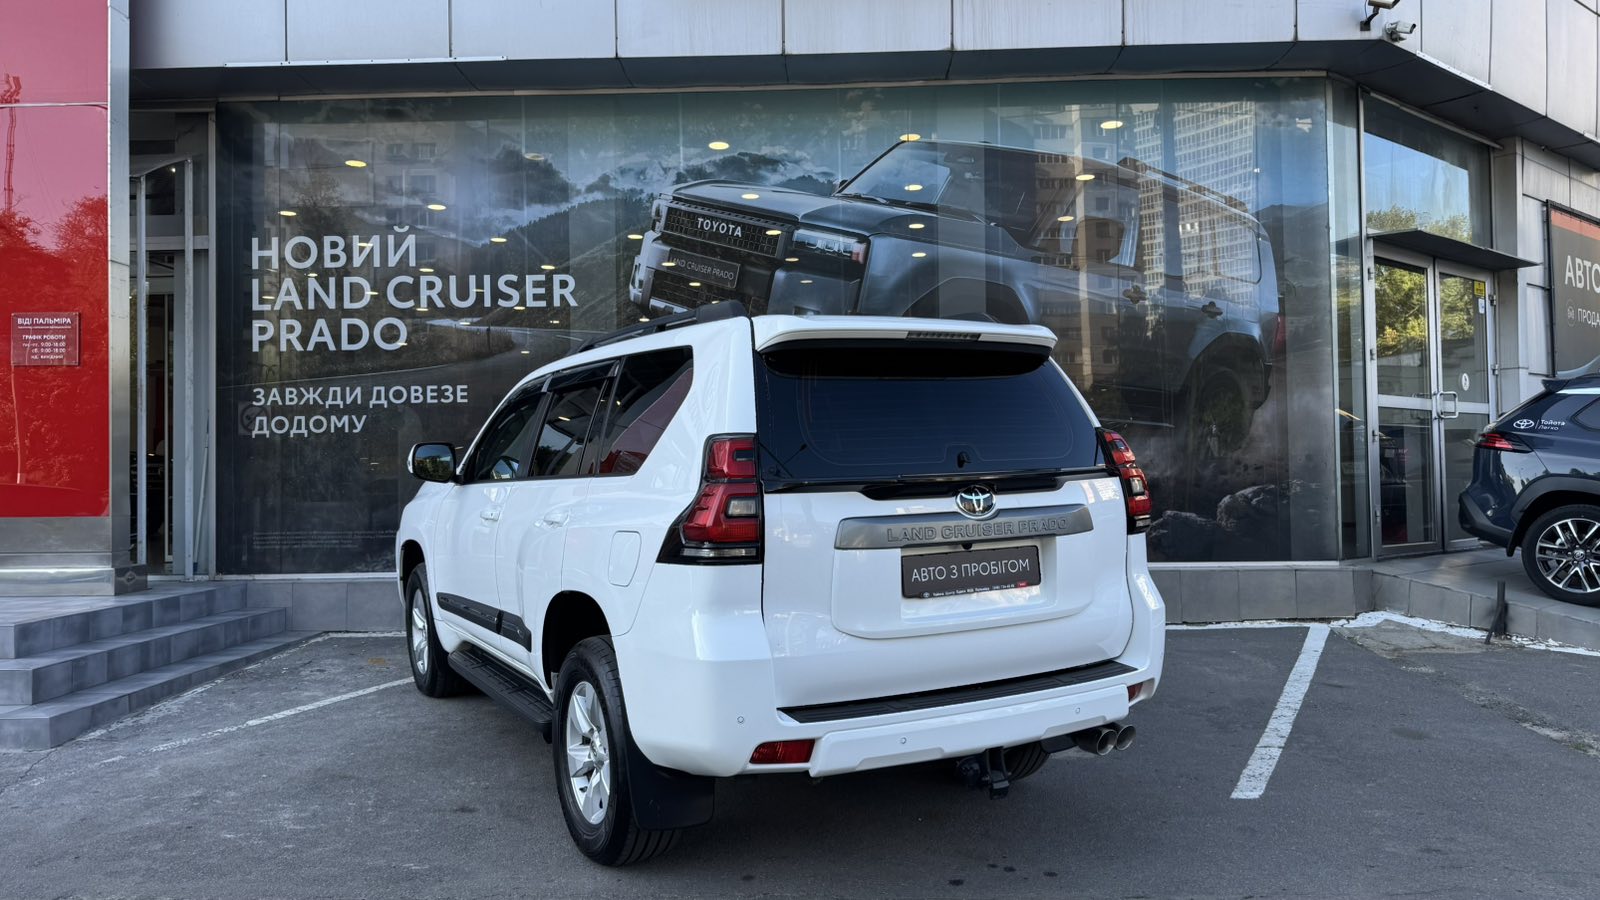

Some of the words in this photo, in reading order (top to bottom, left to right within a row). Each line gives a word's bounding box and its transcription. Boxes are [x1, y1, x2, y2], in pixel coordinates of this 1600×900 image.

[697, 217, 743, 238] TOYOTA
[251, 225, 417, 270] НОВИЙ
[686, 261, 712, 274] CRUISER
[712, 268, 734, 280] PRADO
[251, 276, 372, 311] LAND
[386, 273, 578, 309] CRUISER
[17, 317, 32, 326] ВІДІ
[33, 317, 72, 325] ПАЛЬМІРА
[251, 317, 409, 352] PRADO
[252, 386, 362, 409] ЗАВЖДИ
[369, 384, 469, 409] ДОВЕЗЕ
[252, 414, 367, 438] ДОДОМУ
[886, 525, 938, 543] LAND
[941, 520, 1015, 540] CRUISER
[1018, 517, 1068, 534] PRADO
[911, 565, 947, 582] АВТО
[961, 558, 1030, 578] ПРОБІГОМ
